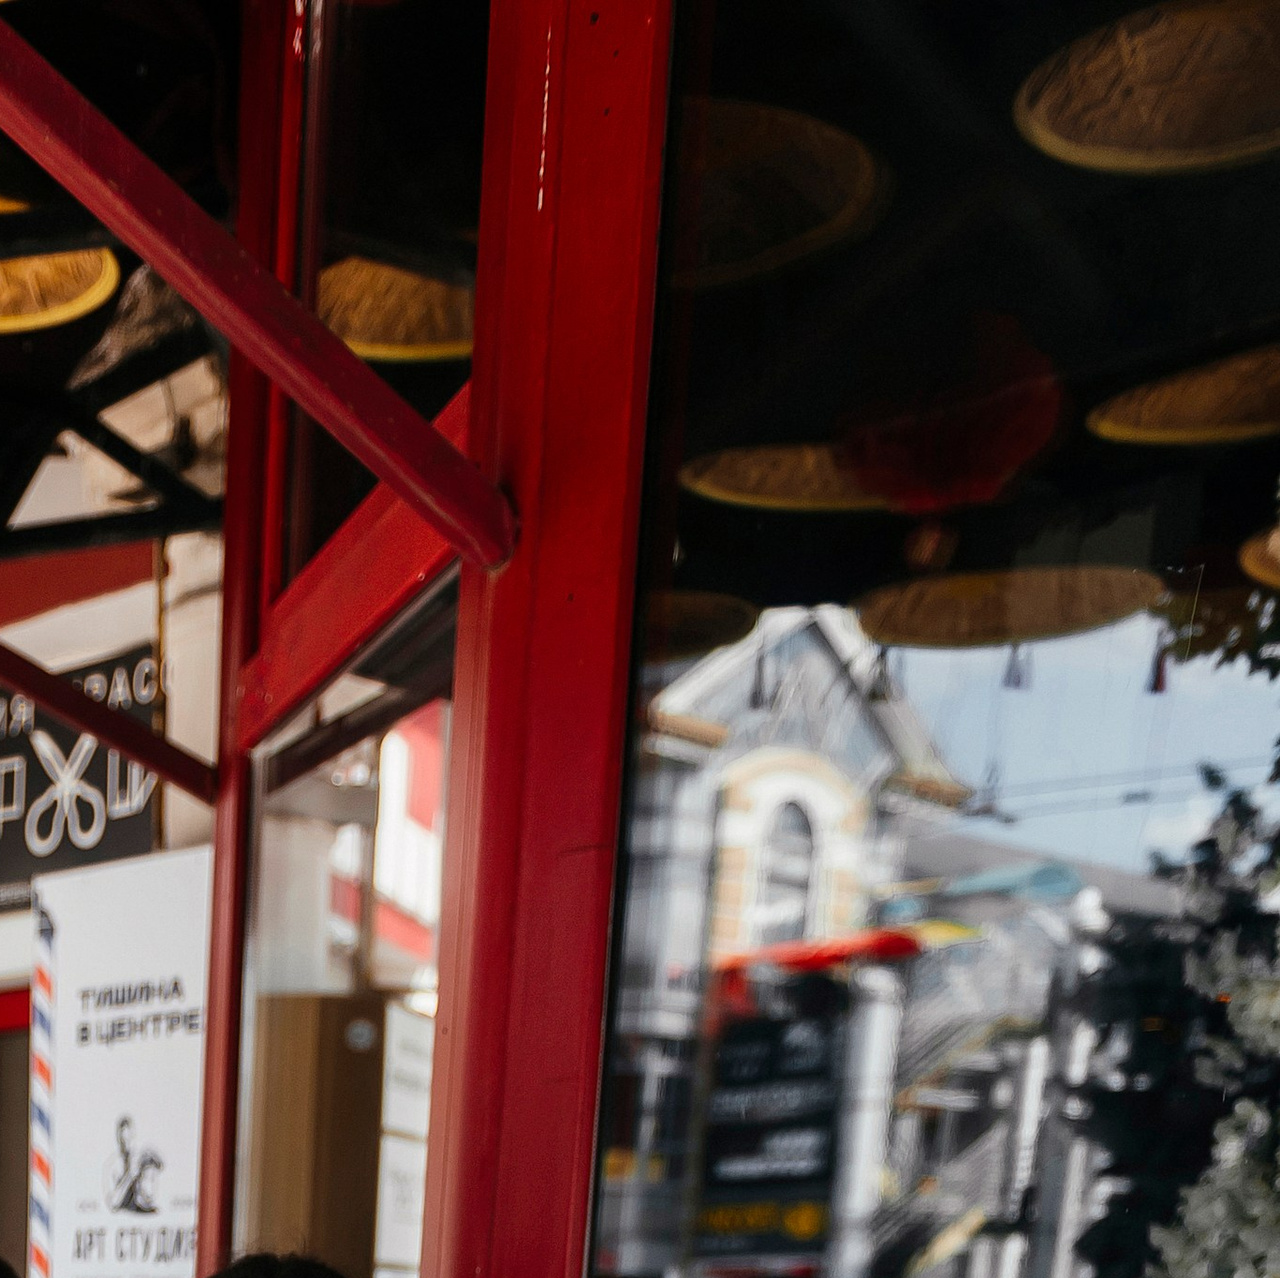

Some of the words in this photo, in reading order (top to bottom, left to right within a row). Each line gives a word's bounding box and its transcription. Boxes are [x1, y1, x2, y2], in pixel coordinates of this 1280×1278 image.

[79, 976, 185, 1012] ТИШИНА
[96, 1008, 200, 1046] ЦЕНТРЕ
[73, 1226, 107, 1261] АРТ
